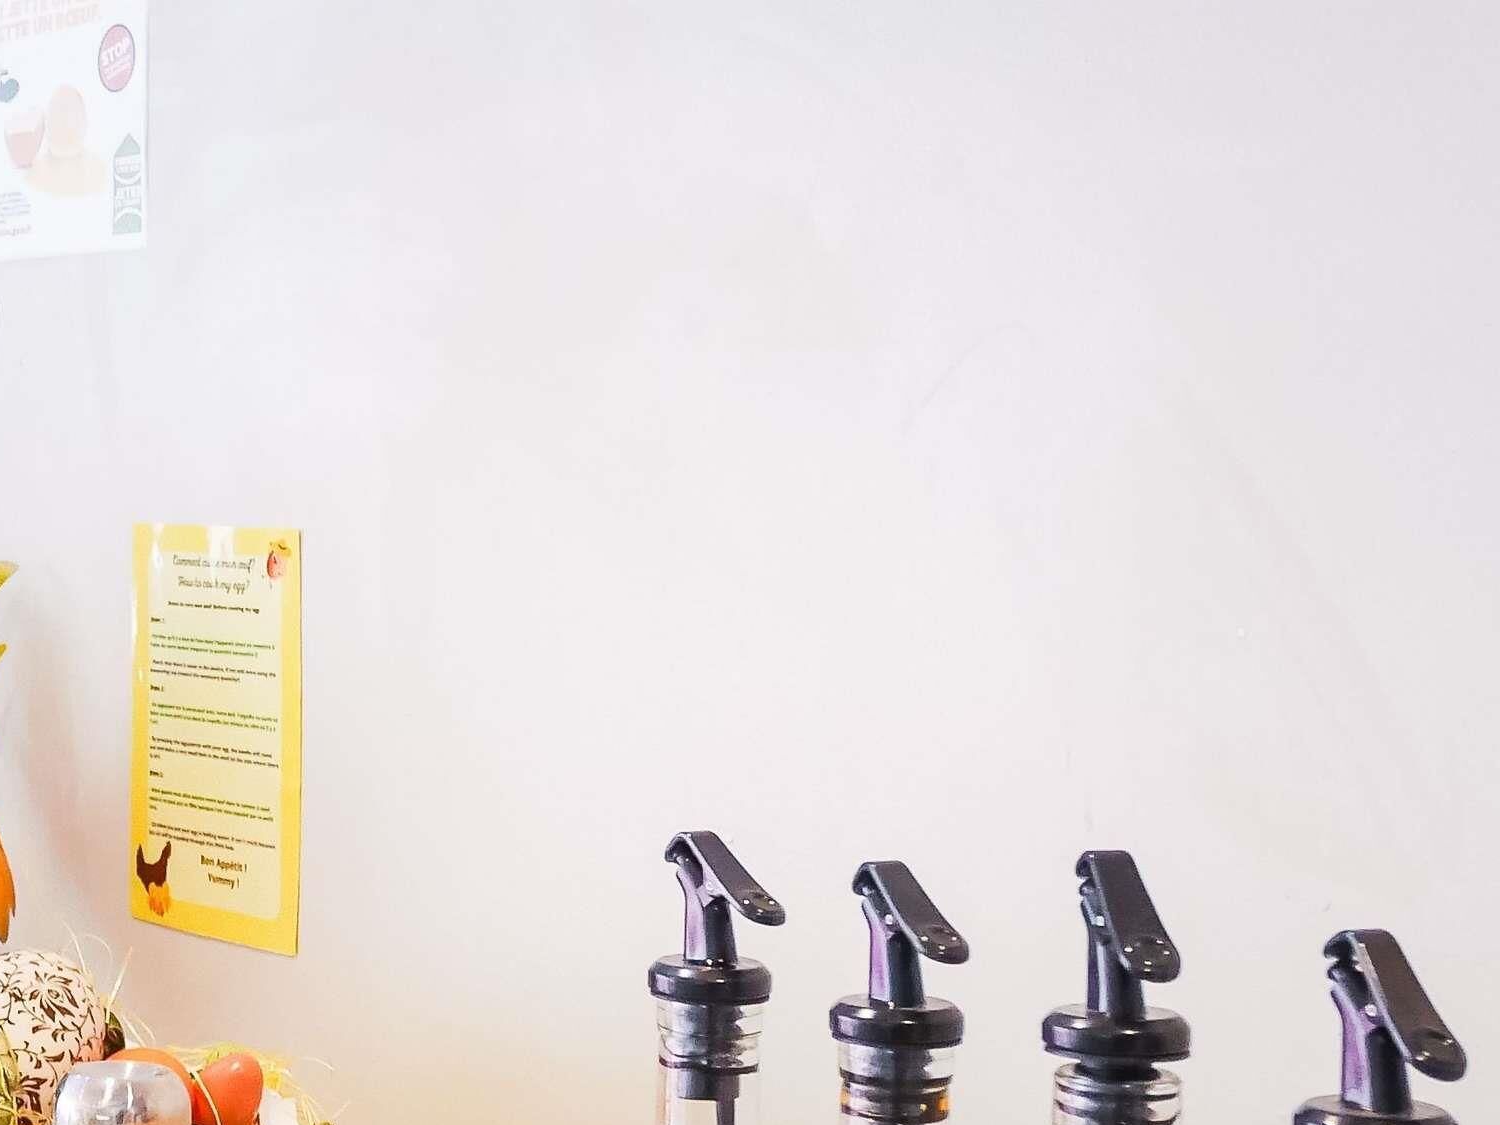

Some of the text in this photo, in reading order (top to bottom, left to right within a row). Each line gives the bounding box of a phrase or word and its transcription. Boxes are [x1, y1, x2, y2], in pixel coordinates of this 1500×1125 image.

[100, 37, 129, 66] STOP
[200, 855, 215, 867] Bon
[208, 873, 235, 889] Yummy
